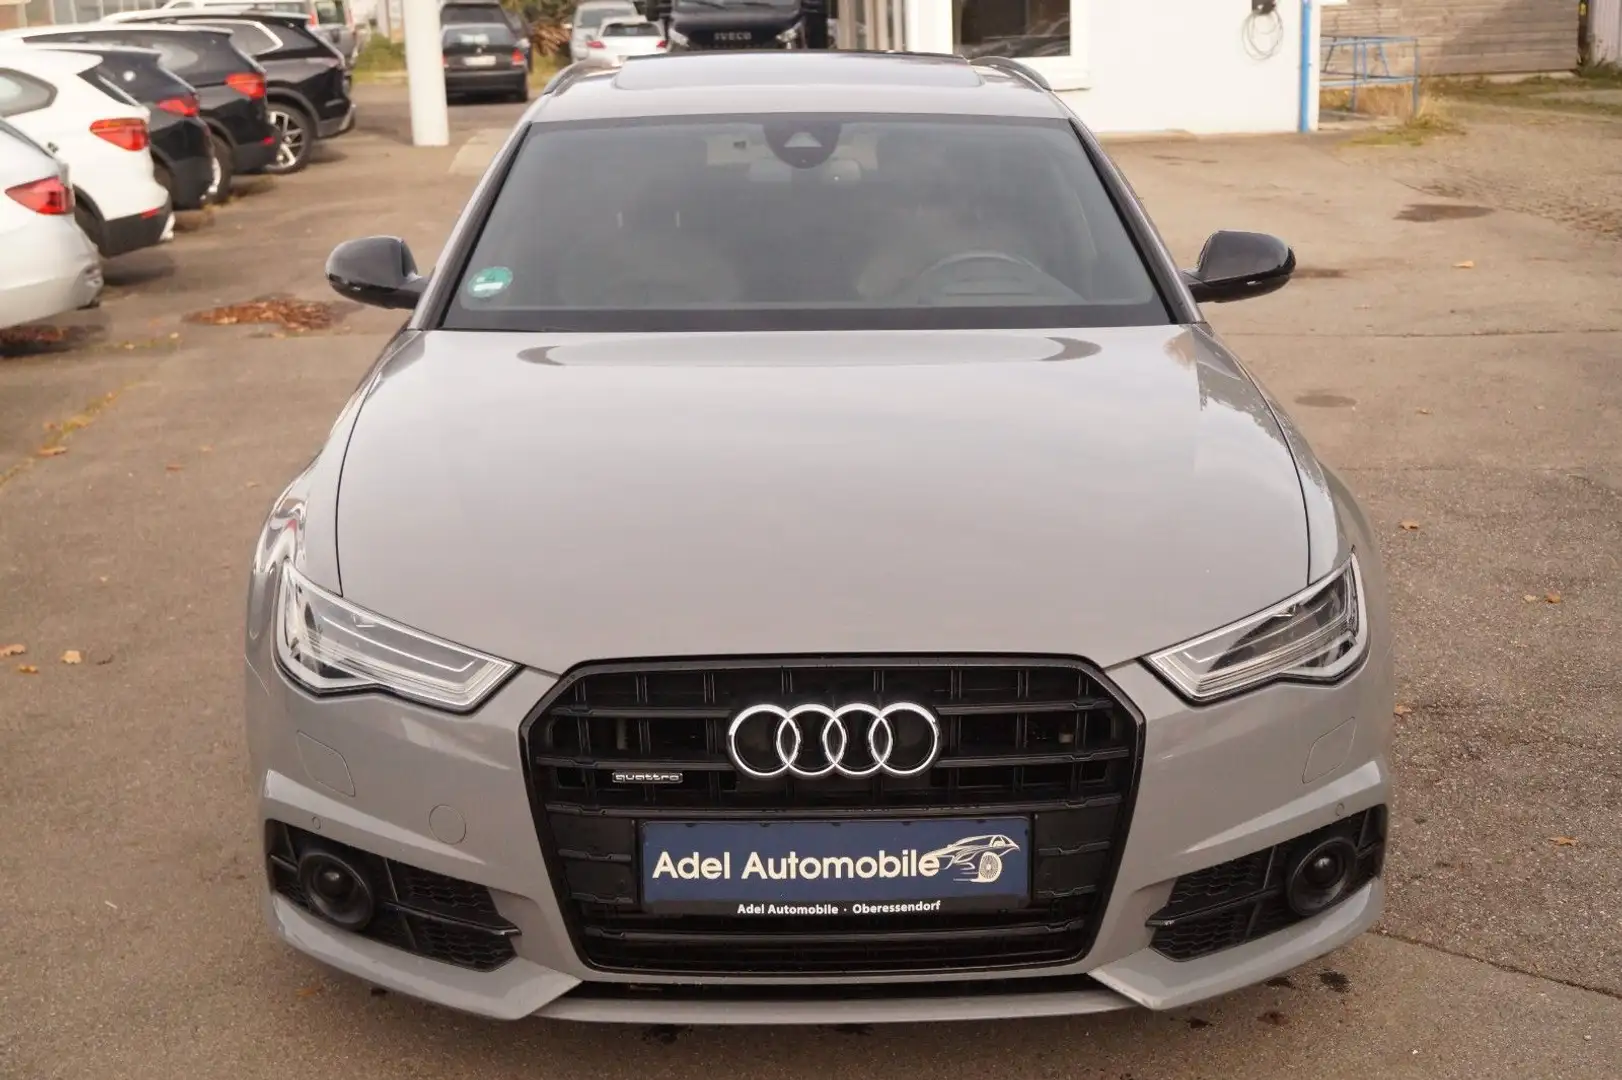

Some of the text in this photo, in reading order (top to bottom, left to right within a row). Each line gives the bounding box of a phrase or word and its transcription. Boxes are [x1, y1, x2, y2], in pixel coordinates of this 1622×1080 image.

[714, 31, 752, 41] IVECO
[615, 773, 680, 782] quattro
[652, 849, 941, 880] Adel Automobile
[737, 899, 941, 915] Adel Automobile Oberessendorf
